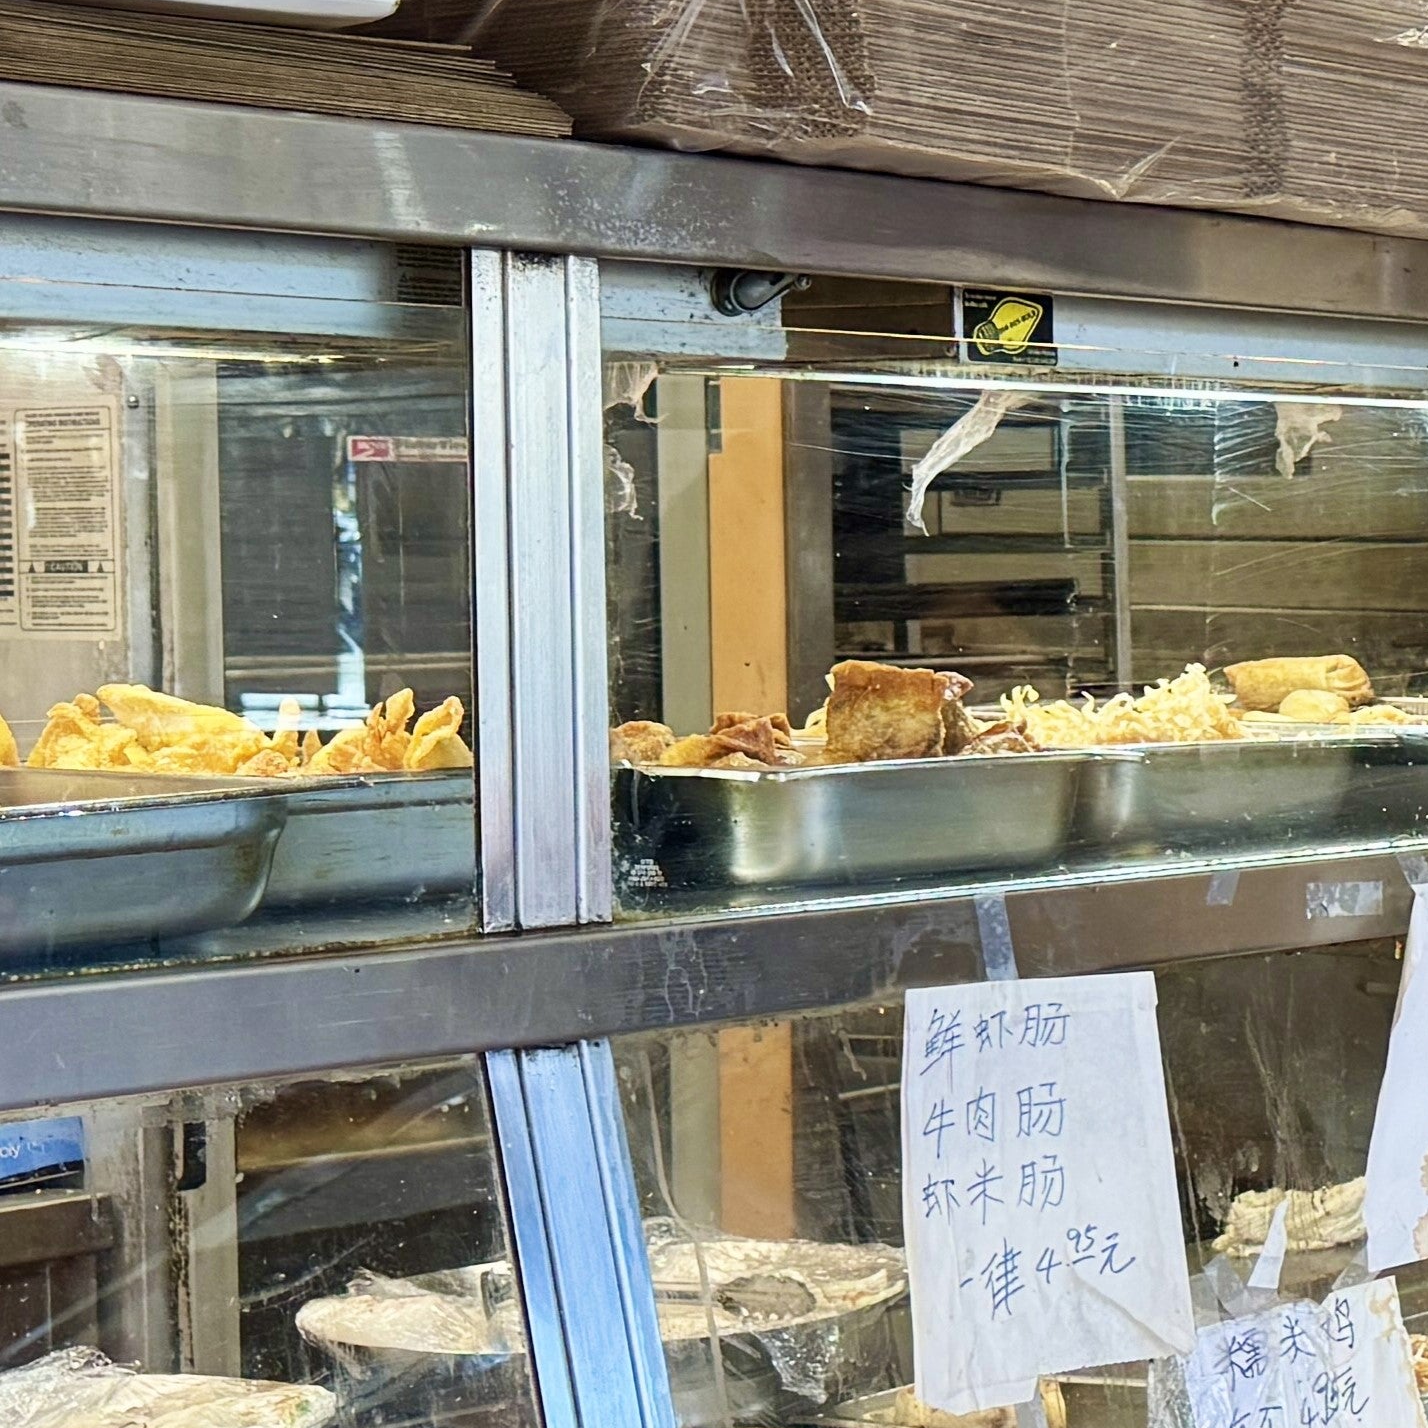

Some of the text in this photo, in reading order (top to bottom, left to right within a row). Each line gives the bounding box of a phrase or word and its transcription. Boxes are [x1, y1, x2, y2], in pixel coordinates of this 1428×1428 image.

[922, 1081, 1066, 1159] 牛肉肠
[922, 1154, 1065, 1225] 虾米肠
